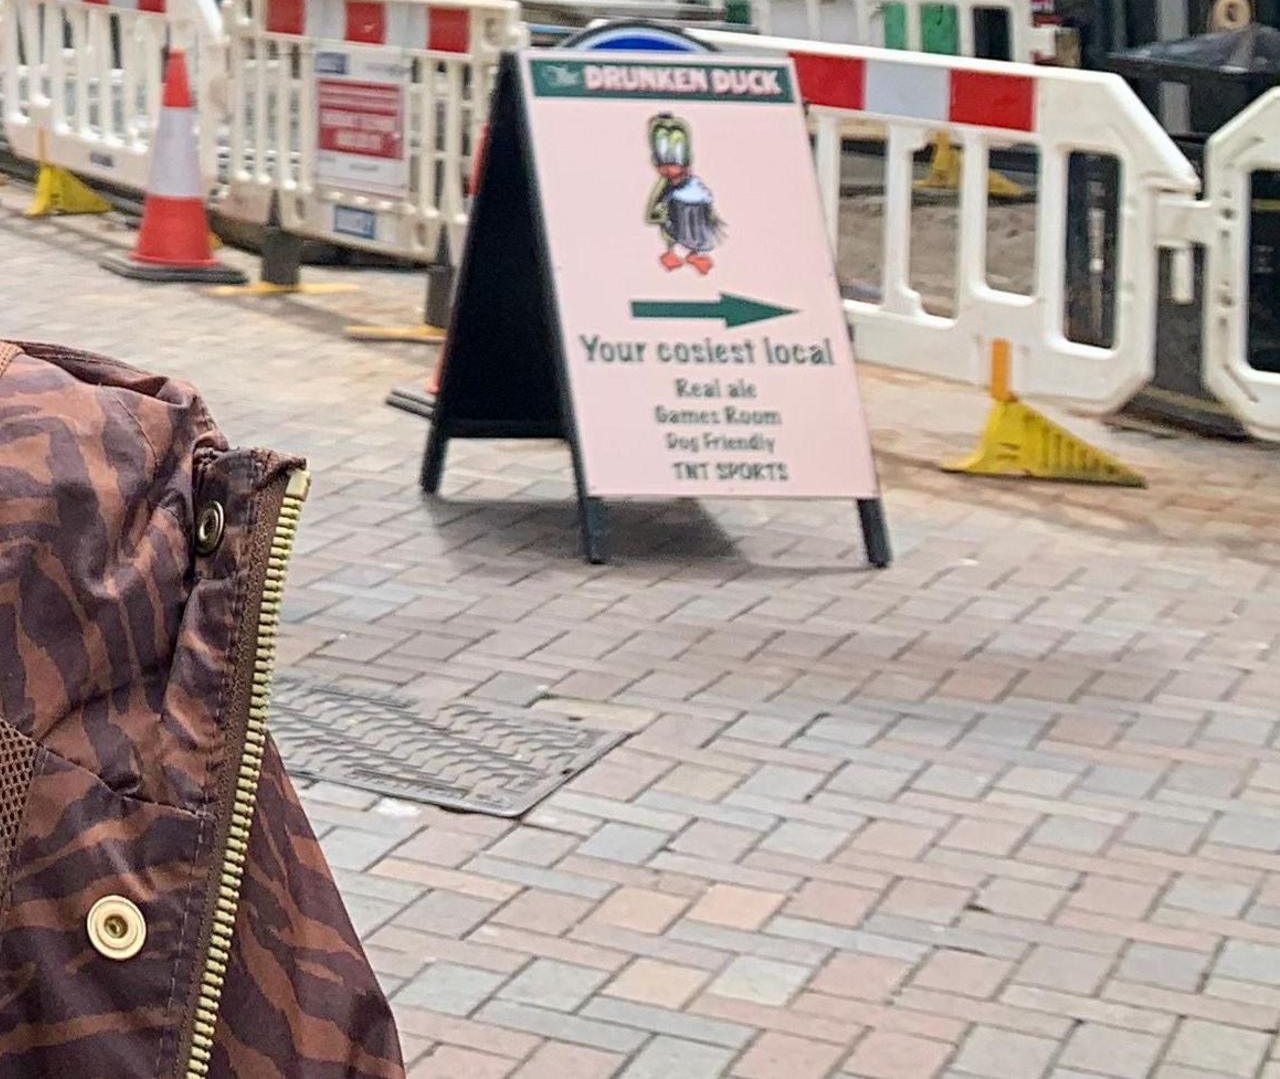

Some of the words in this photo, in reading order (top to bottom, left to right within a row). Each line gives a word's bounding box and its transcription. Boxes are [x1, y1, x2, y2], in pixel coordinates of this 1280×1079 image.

[582, 64, 709, 93] DRUNKEN
[710, 69, 782, 95] DUCK
[580, 334, 647, 363] Your
[656, 337, 755, 364] cosiest
[763, 337, 834, 365] local
[674, 378, 721, 398] Real
[726, 379, 757, 398] ale
[654, 405, 721, 425] Games
[723, 406, 782, 425] Room
[665, 432, 699, 453] Dog
[702, 432, 775, 454] Friendly
[672, 461, 709, 481] TNT
[716, 462, 789, 481] SPORTS
